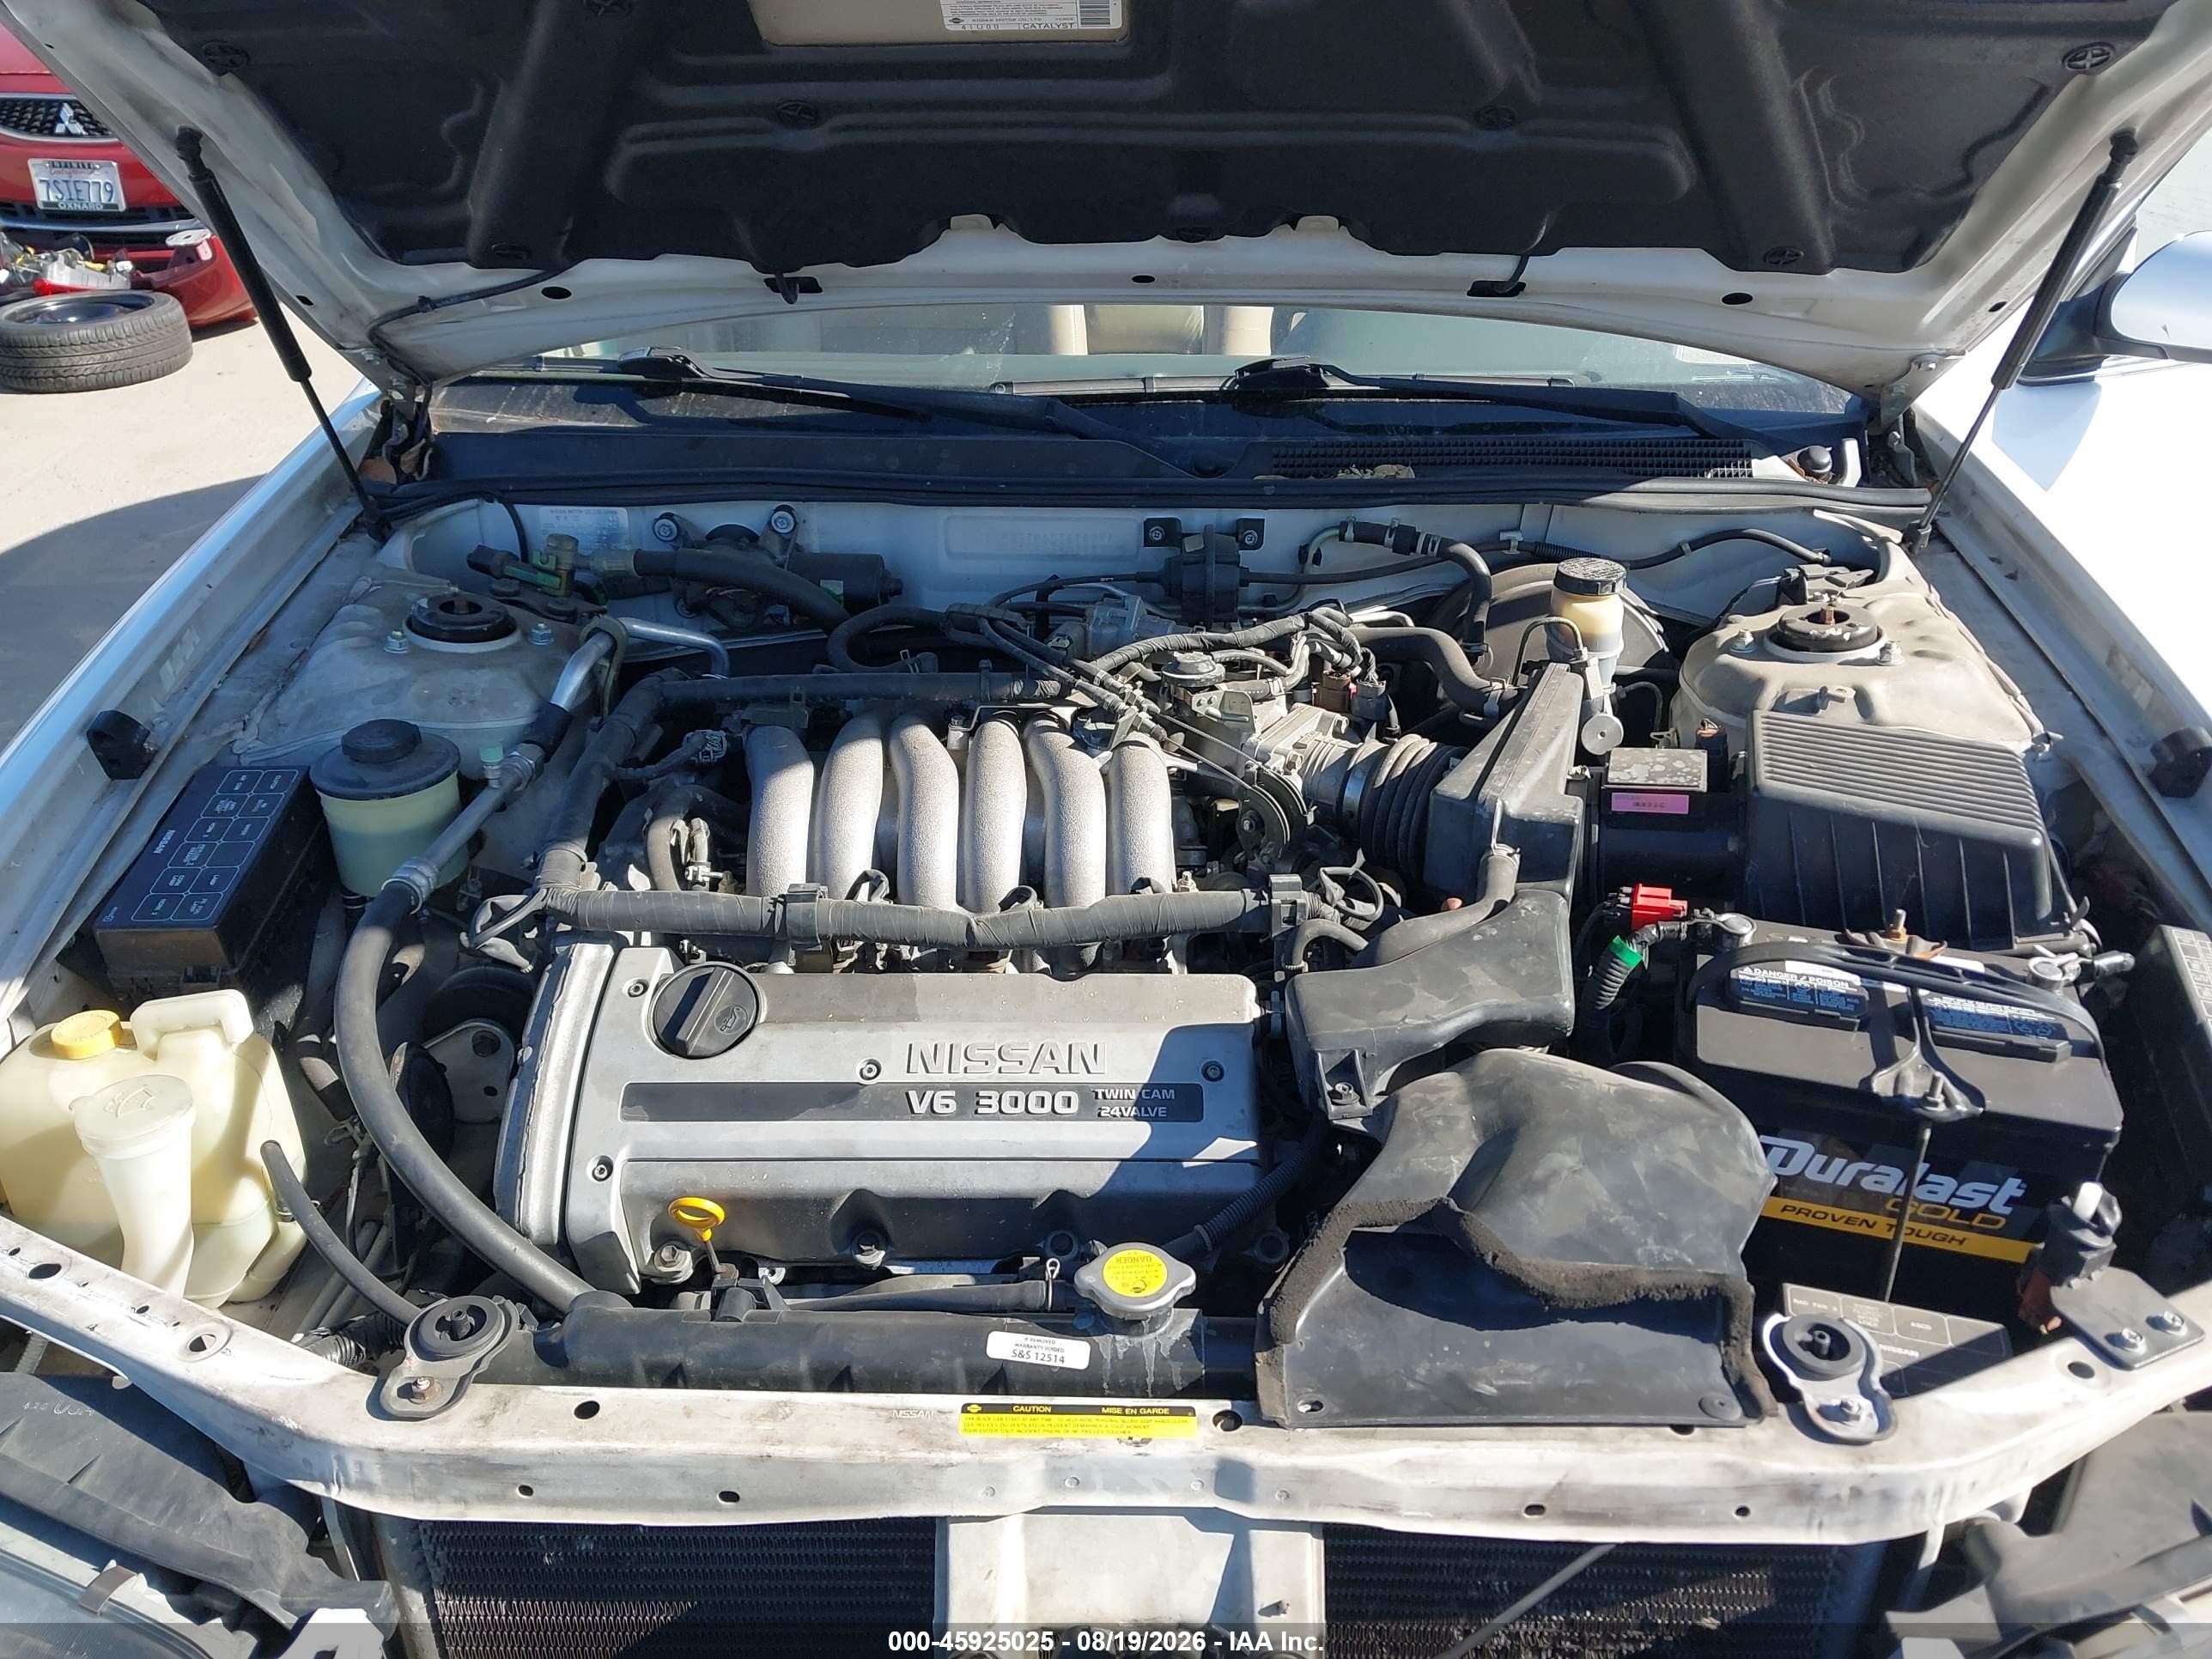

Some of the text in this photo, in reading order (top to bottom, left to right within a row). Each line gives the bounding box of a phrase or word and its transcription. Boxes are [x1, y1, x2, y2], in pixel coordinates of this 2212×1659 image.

[39, 179, 114, 203] 7SIE779
[58, 202, 104, 210] OXNARD
[153, 830, 176, 854] NISSAN
[1754, 969, 1798, 981] DANGER
[1808, 975, 1849, 988] POISON
[906, 1041, 1108, 1074] NISSAN
[1093, 1088, 1176, 1101] TWIN CAM
[906, 1090, 1079, 1115] V6 3000
[1098, 1105, 1168, 1118] 24VALVE
[1885, 1198, 2006, 1231] GOLD
[1781, 1204, 1966, 1245] PROVEN TOUGH
[1116, 1255, 1152, 1264] DANGER
[1014, 1342, 1044, 1351] WARRANTY
[1879, 1343, 1919, 1358] NISSAN
[1012, 1348, 1066, 1364] S&S 12514
[892, 1409, 934, 1419] NISSAN
[1012, 1405, 1052, 1413] CAUTION
